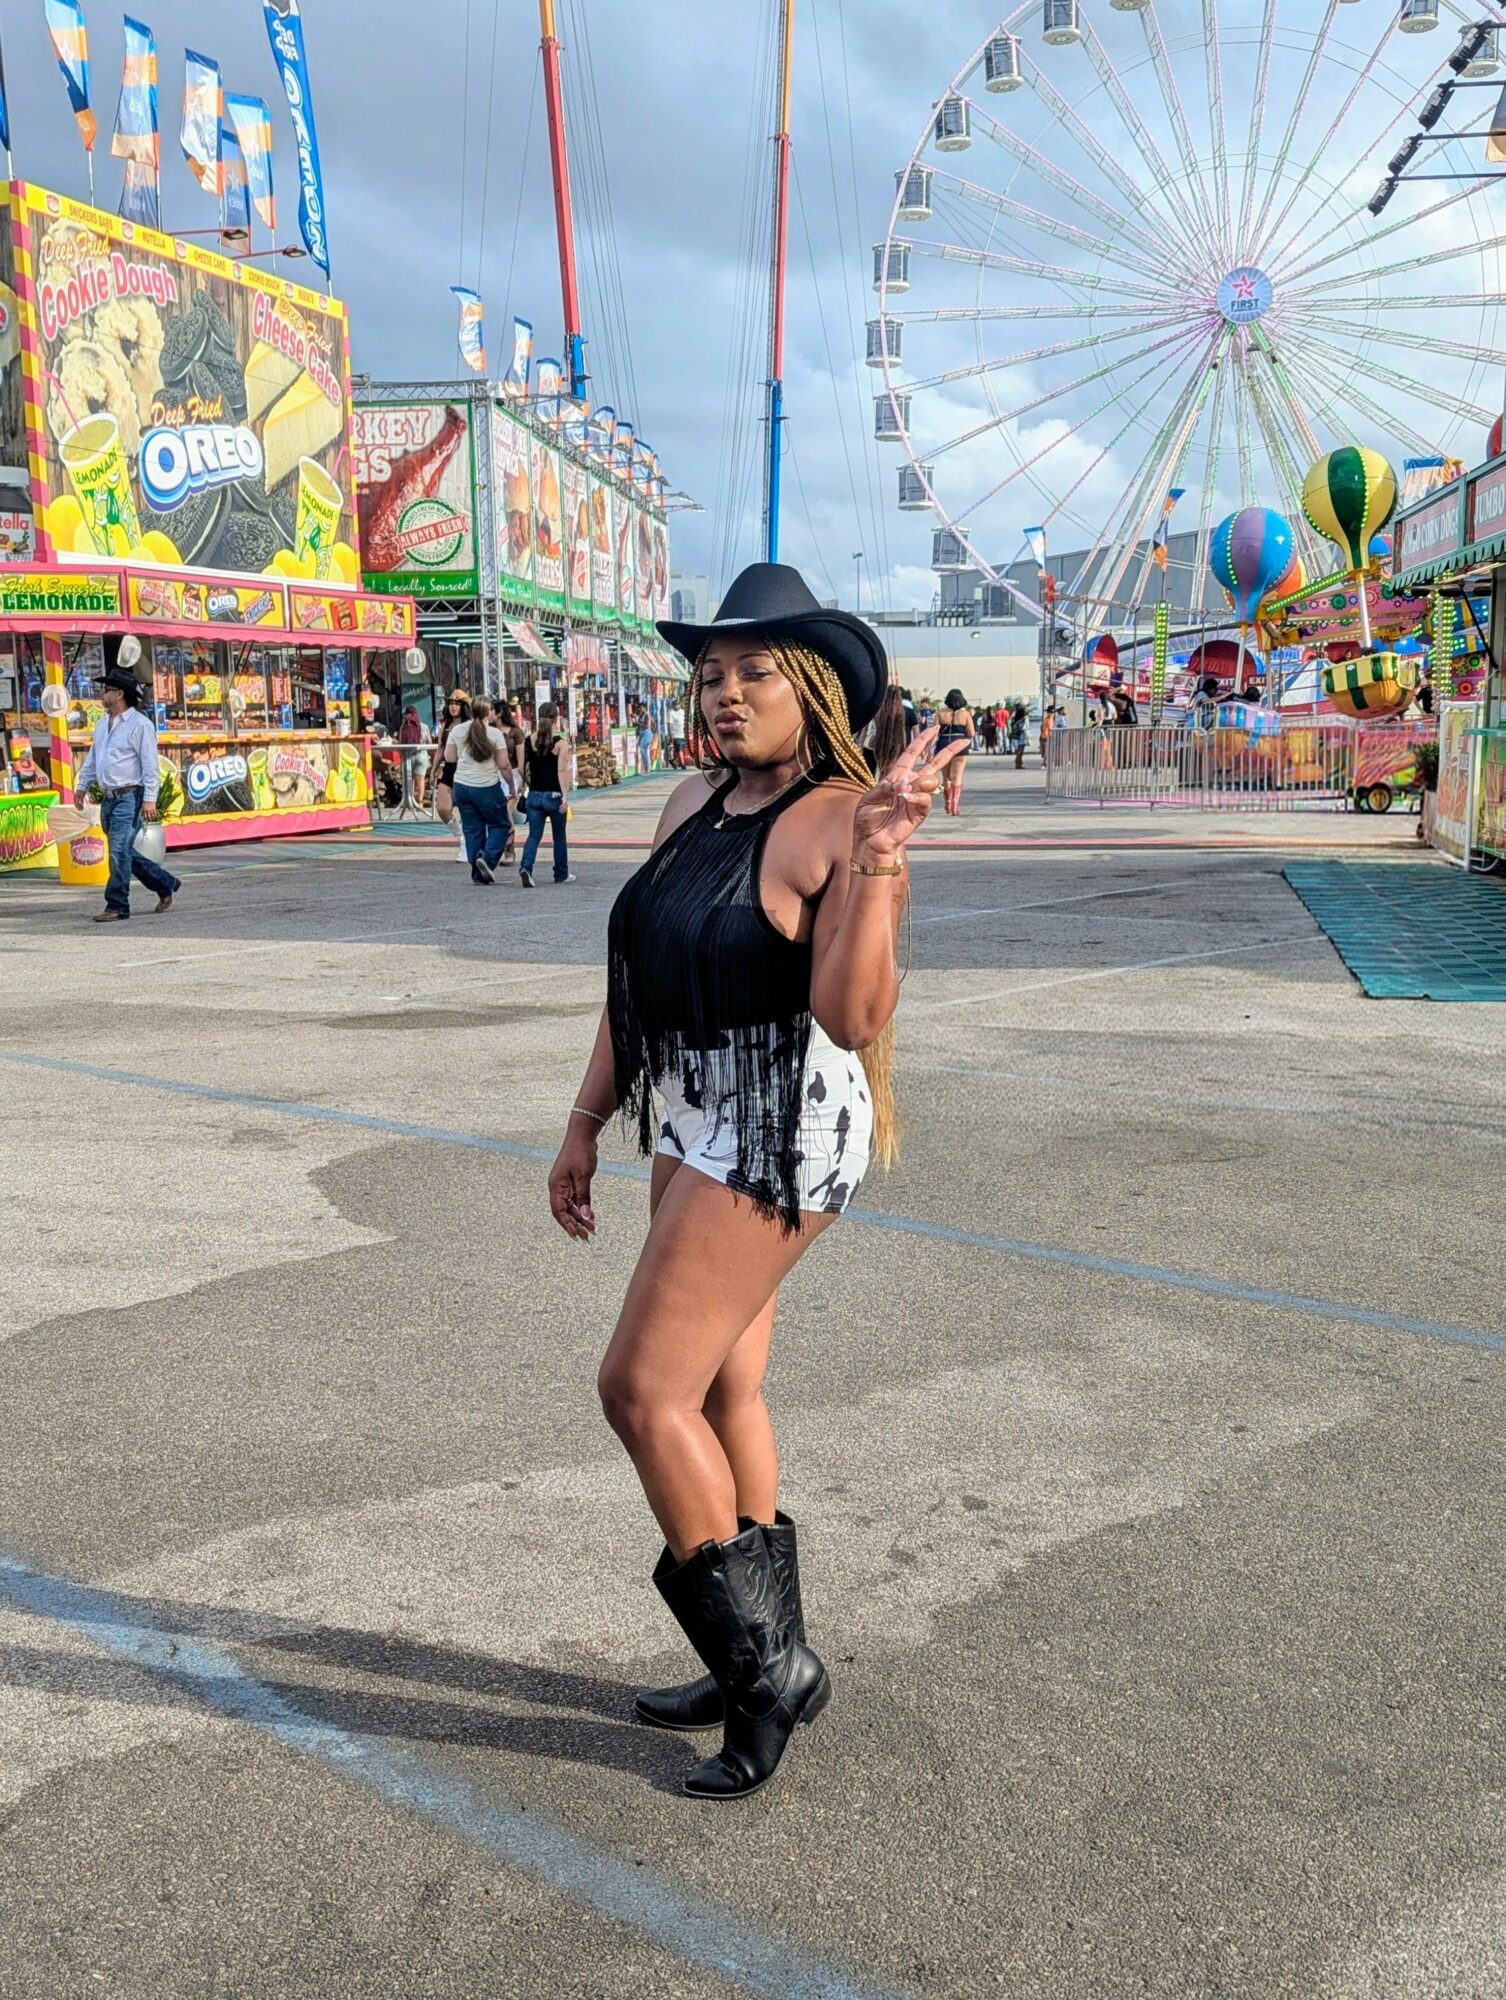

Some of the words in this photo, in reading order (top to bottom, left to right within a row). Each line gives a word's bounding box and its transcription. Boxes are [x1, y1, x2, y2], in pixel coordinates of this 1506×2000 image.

[69, 204, 98, 226] SNICKERS
[98, 217, 114, 231] BARS
[142, 231, 166, 248] NUTELLA
[41, 234, 75, 265] Deep
[76, 230, 111, 261] Fried
[41, 258, 110, 341] Cookie
[111, 253, 178, 306] Dough
[1230, 298, 1260, 310] FIRST
[253, 291, 305, 366] Cheese
[306, 342, 342, 404] Cake
[306, 320, 333, 356] Fried
[151, 401, 186, 429] Deep
[187, 393, 224, 426] Fried
[72, 450, 118, 486] LEMONADE
[142, 427, 262, 496] OREO
[301, 485, 334, 519] LEMONADE
[1474, 482, 1506, 527] JUMBO
[400, 526, 437, 549] ALWAYS
[437, 518, 464, 538] FRESH
[2, 593, 115, 611] LEMONADE
[3, 576, 42, 595] Fresh
[46, 577, 107, 596] Squeezed
[208, 594, 237, 611] OREO
[388, 578, 426, 596] Locally
[189, 755, 247, 794] OREO
[274, 752, 302, 773] Cookie
[302, 758, 326, 790] Dough
